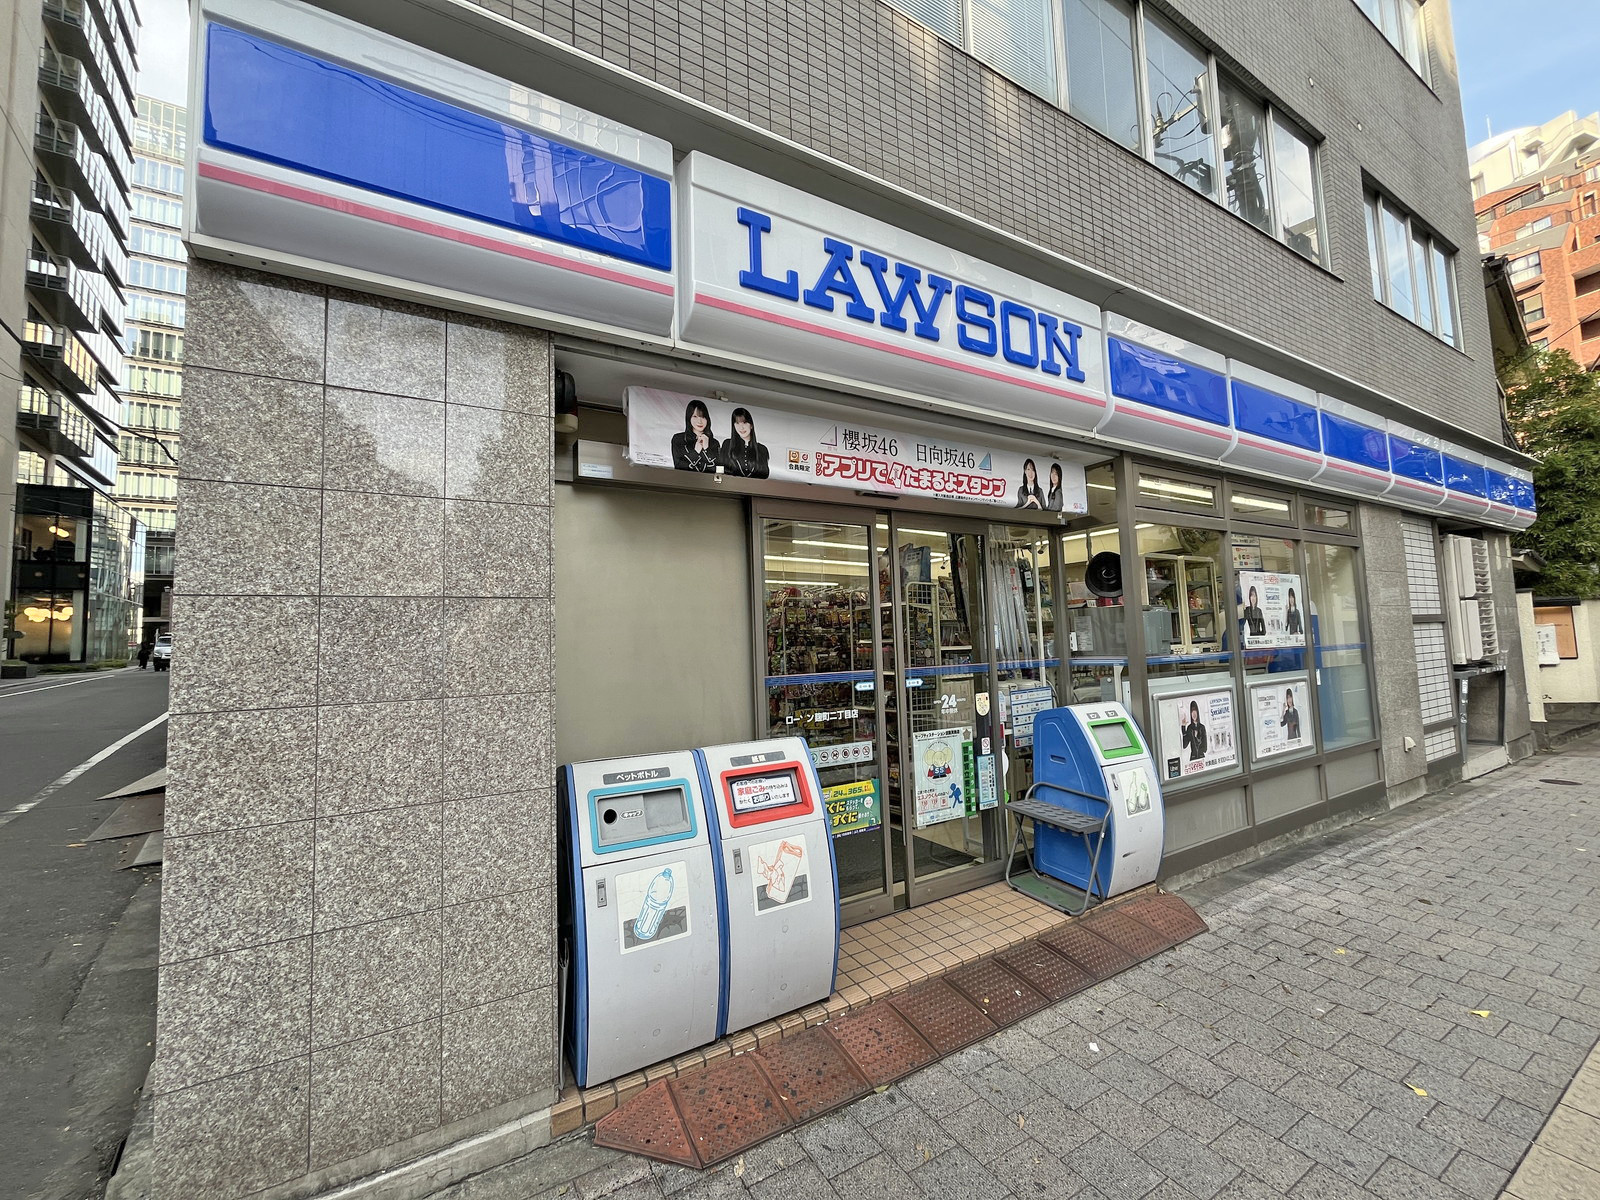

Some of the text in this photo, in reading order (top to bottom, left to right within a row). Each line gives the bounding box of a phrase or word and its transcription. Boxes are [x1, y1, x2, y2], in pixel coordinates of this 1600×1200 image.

[737, 207, 1085, 382] LAWSON
[842, 429, 898, 456] 櫻坂46
[916, 443, 975, 469] 日向坂46
[788, 463, 810, 472] 会員限定
[823, 453, 1006, 497] アプリで たまるよスタンプ
[941, 694, 957, 708] 24
[616, 770, 658, 781] ペットボトル
[833, 811, 858, 827] すぐに
